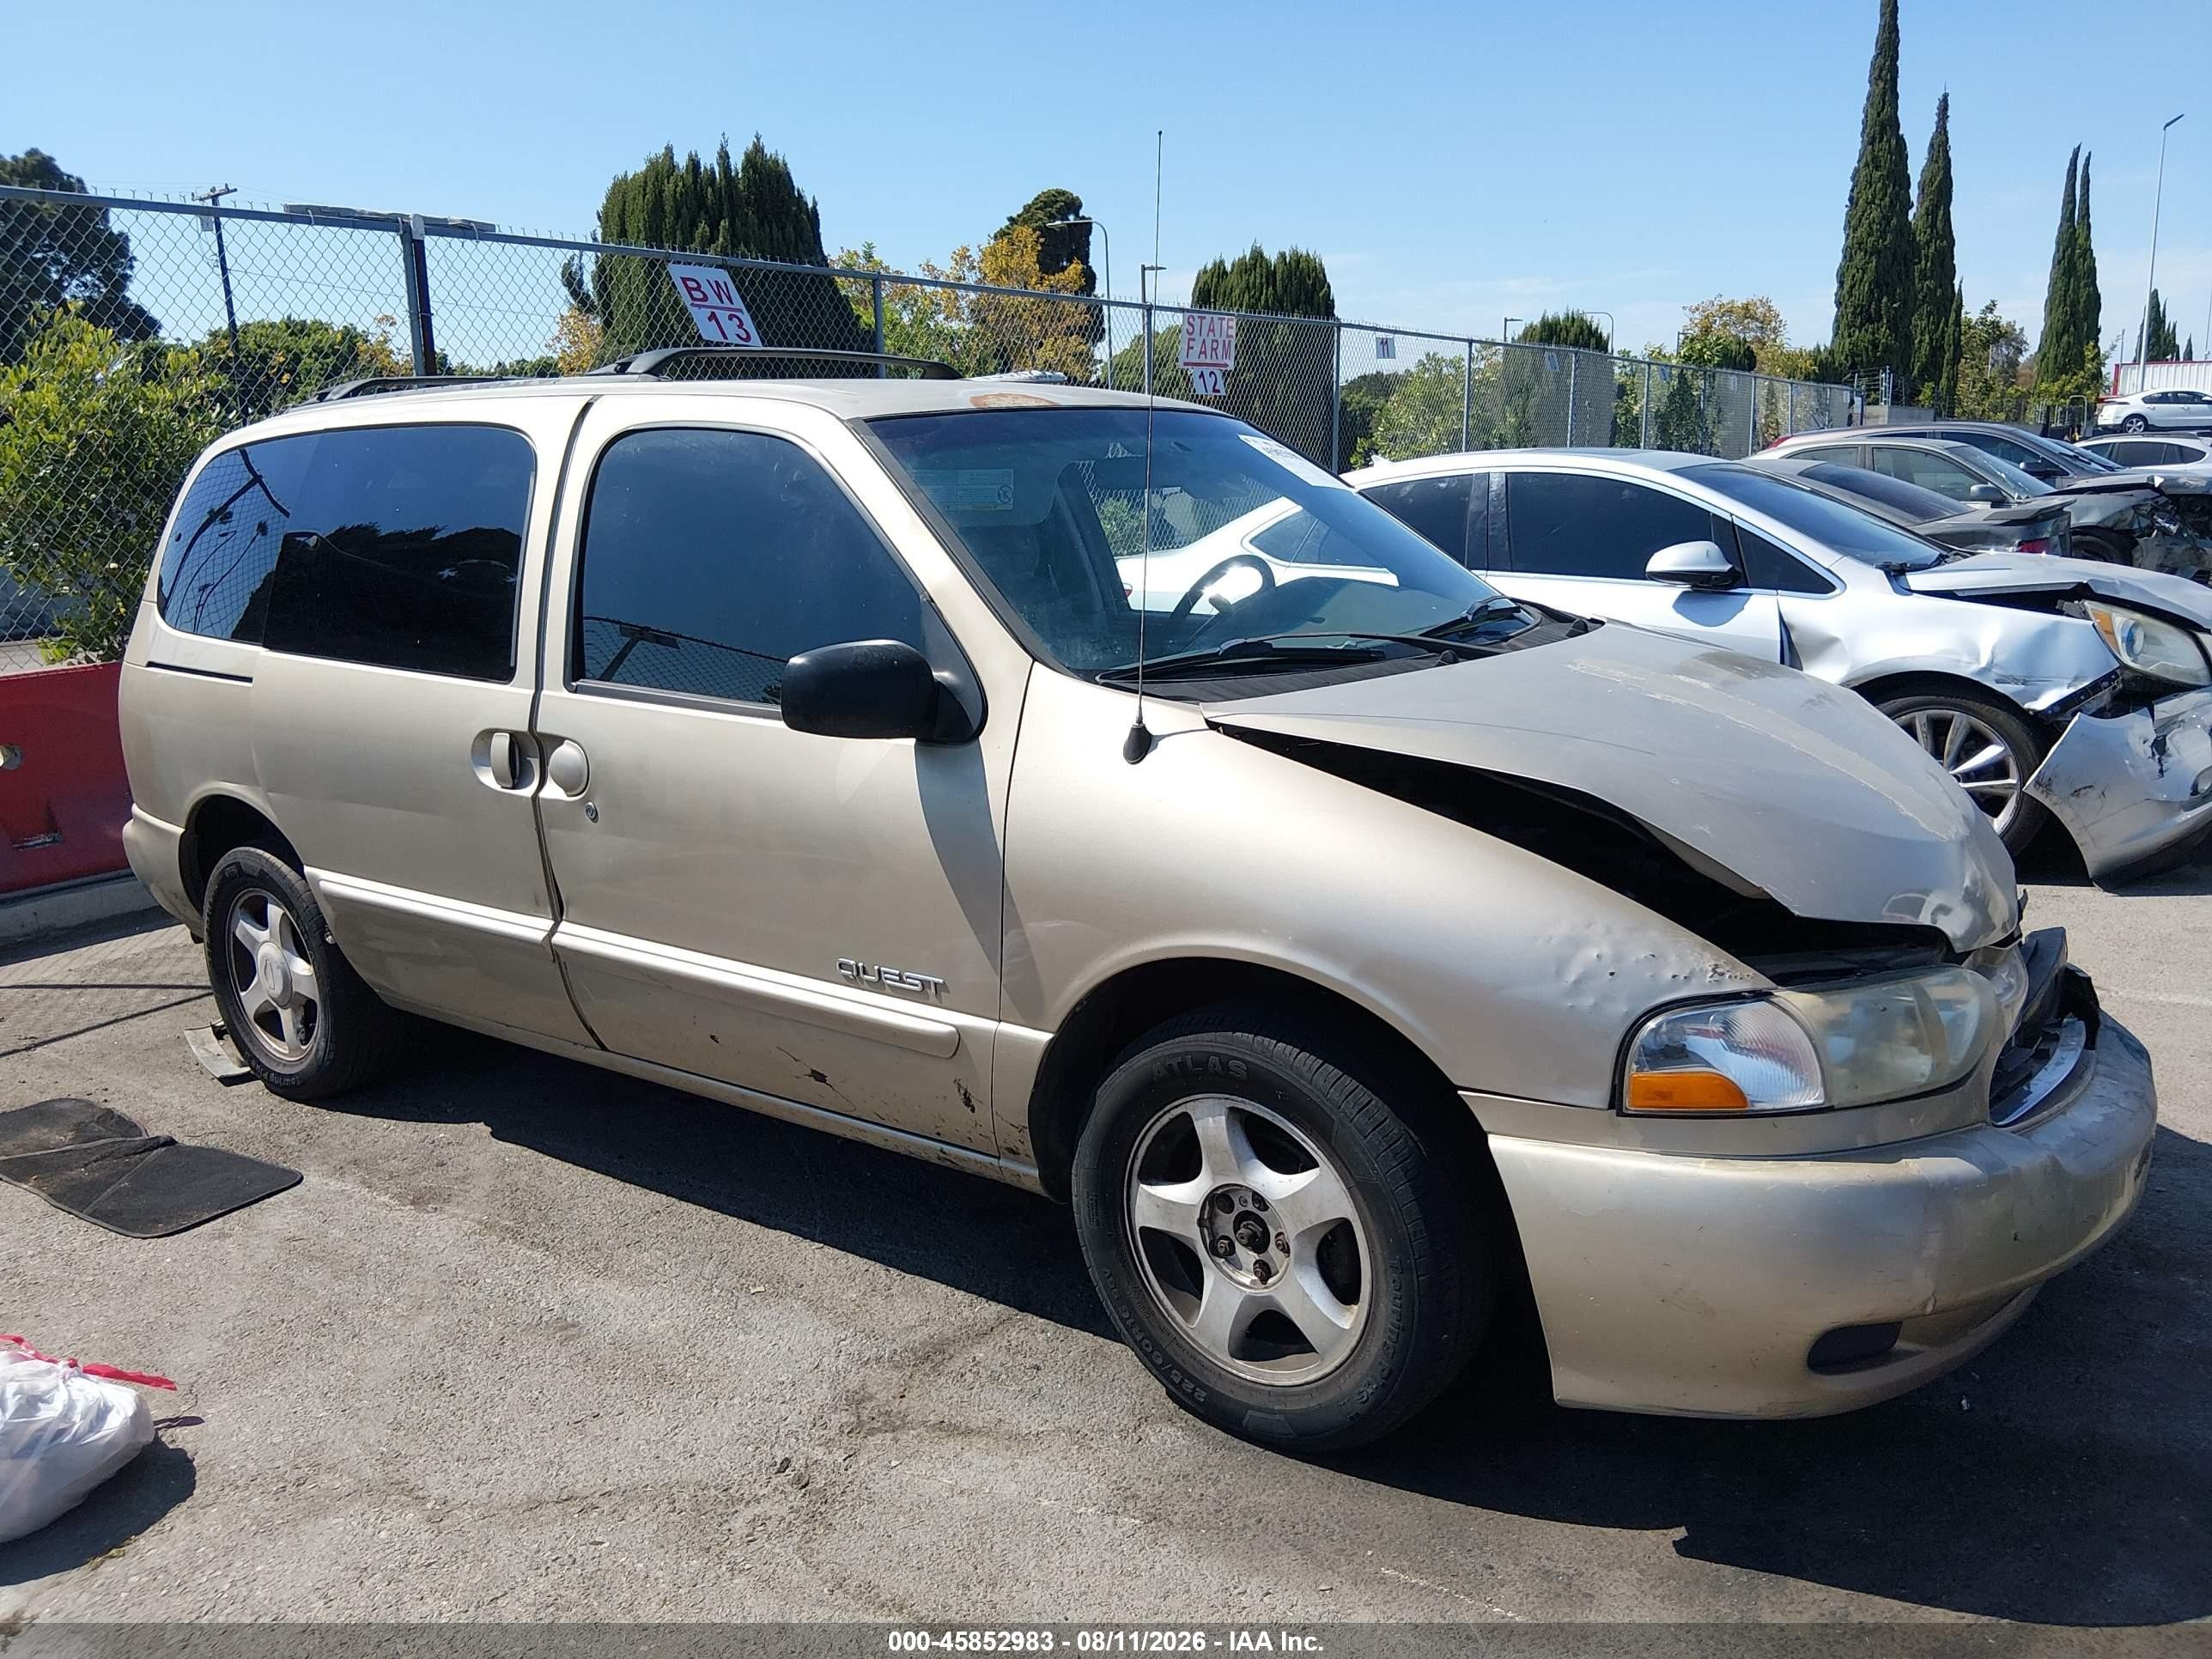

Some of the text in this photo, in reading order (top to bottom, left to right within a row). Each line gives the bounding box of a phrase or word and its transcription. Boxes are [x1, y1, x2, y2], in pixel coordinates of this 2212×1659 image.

[680, 276, 734, 305] BW
[708, 311, 751, 343] 13
[1186, 314, 1234, 338] STATE
[1187, 338, 1231, 360] FARM
[1199, 371, 1220, 393] 12
[837, 957, 945, 995] QUEST
[1152, 1054, 1249, 1081] ATLAS
[1382, 1256, 1406, 1359] Touring
